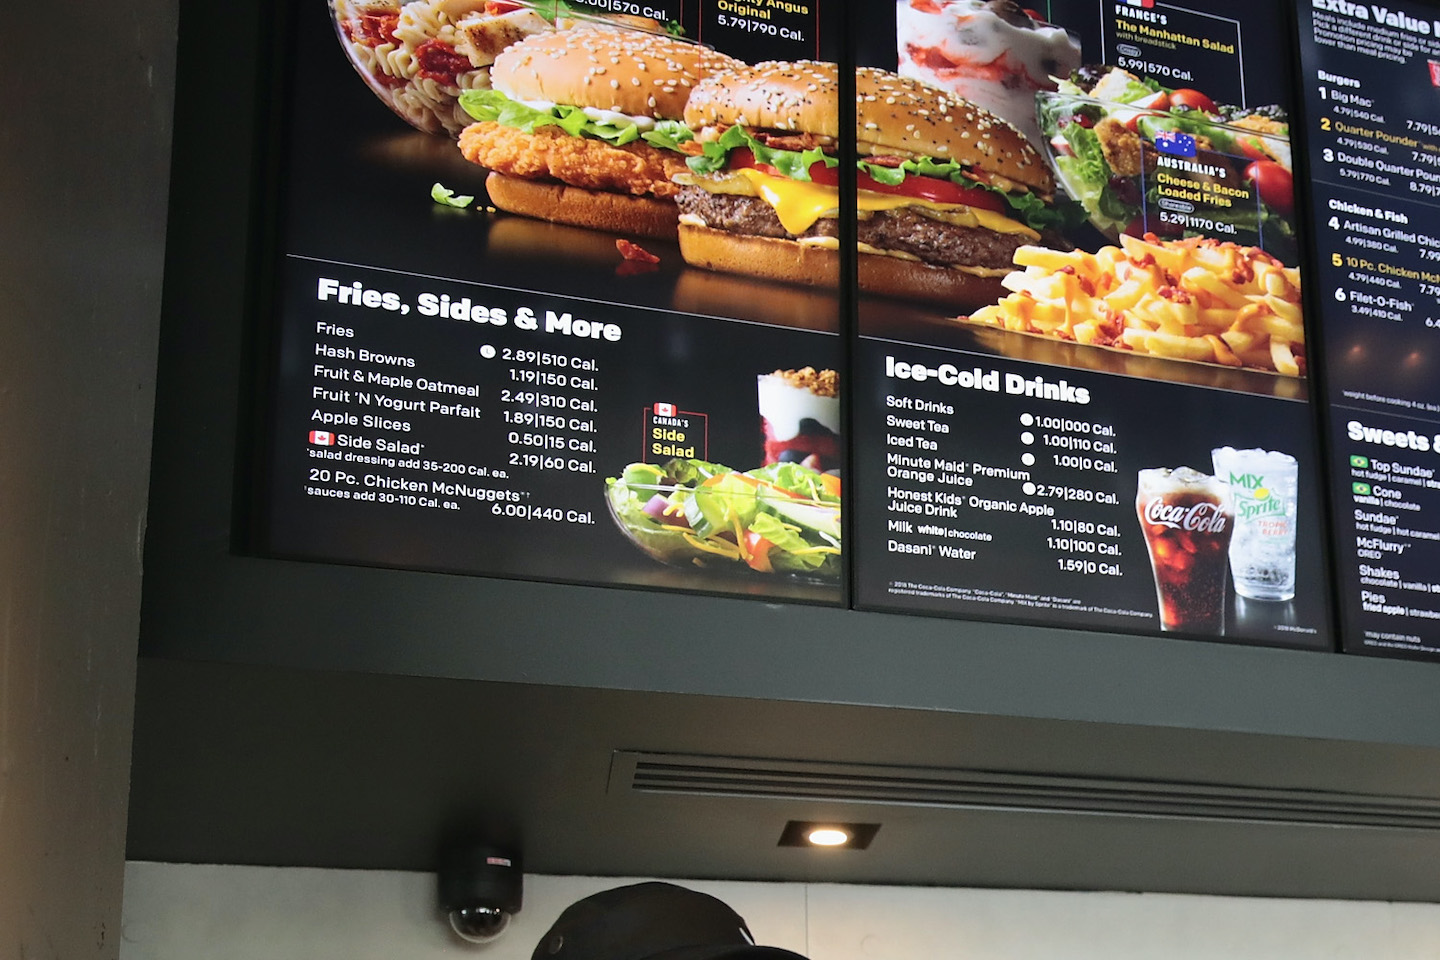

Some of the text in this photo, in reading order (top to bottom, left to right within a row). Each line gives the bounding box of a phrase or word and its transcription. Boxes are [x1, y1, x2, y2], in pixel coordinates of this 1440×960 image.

[717, 0, 771, 20] Original
[766, 0, 809, 14] Angus
[1115, 4, 1167, 25] FRANCE'S
[717, 14, 805, 42] 5.79|790 Cal.
[1371, 6, 1430, 34] Value
[1115, 19, 1234, 53] The Manhattan Salad
[1118, 56, 1193, 81] 5.99|570 Cal.
[1317, 70, 1360, 88] Burgers
[1318, 86, 1371, 107] 1 Big Mac
[1321, 117, 1417, 147] 2 Quarter Pounder
[1157, 156, 1225, 178] AUSTRALIA'S
[1323, 148, 1334, 162] 3
[1337, 152, 1374, 168] Double
[1375, 160, 1414, 176] Quarter
[1157, 173, 1250, 199] Cheese & Bacon
[1158, 185, 1231, 207] Loaded Fries
[1328, 199, 1408, 224] Chicken & Fish
[1328, 216, 1340, 230] 4
[1343, 220, 1381, 236] Artisan
[1382, 227, 1416, 243] Grilled
[1332, 253, 1342, 266] 5
[1346, 257, 1358, 267] 10
[1360, 259, 1376, 271] Pc.
[1378, 263, 1419, 279] Chicken
[1335, 287, 1346, 301] 6
[317, 278, 621, 341] Fries, Sides & More
[317, 321, 354, 337] Fries
[315, 343, 415, 367] Hash Browns
[502, 348, 598, 371] 2.89|510 Cal.
[314, 364, 479, 397] Fruit & Maple Oatmeal
[509, 369, 598, 390] 1.19|150 Cal.
[886, 356, 1090, 404] Ice-Cold Drinks
[313, 386, 350, 402] Fruit
[374, 394, 425, 411] Yogurt
[429, 401, 480, 418] Parfait
[886, 395, 954, 414] Soft Drinks
[311, 409, 410, 431] Apple Slices
[652, 416, 689, 428] CANADA'S
[886, 415, 949, 433] Sweet Tea
[337, 434, 372, 449] Side
[652, 427, 686, 443] Side
[887, 433, 937, 450] Iced Tea
[1043, 434, 1117, 454] 1.00|110 Cal.
[1347, 421, 1430, 451] Sweets
[652, 442, 695, 458] Salad
[344, 452, 395, 467] dressing
[398, 459, 420, 469] add
[423, 460, 465, 474] 35-200
[468, 465, 489, 476] Cal.
[492, 470, 508, 478] ea.
[887, 453, 931, 468] Minute
[973, 463, 1030, 480] Premium
[1370, 459, 1390, 474] Top
[309, 468, 330, 481] 20
[335, 471, 359, 485] Pc.
[364, 474, 428, 492] Chicken
[887, 466, 973, 486] Orange Juice
[1230, 471, 1264, 489] MIX
[887, 486, 932, 502] Honest
[969, 496, 1017, 512] Organic
[1019, 502, 1054, 516] Apple
[1372, 485, 1401, 499] Cone
[887, 500, 957, 518] Juice Drink
[1144, 496, 1227, 533] Coca-Cola
[1237, 498, 1281, 519] Sprite
[888, 520, 912, 533] Milk
[938, 545, 976, 559] Water
[1359, 564, 1399, 579] Shakes
[1361, 591, 1385, 603] Pies
